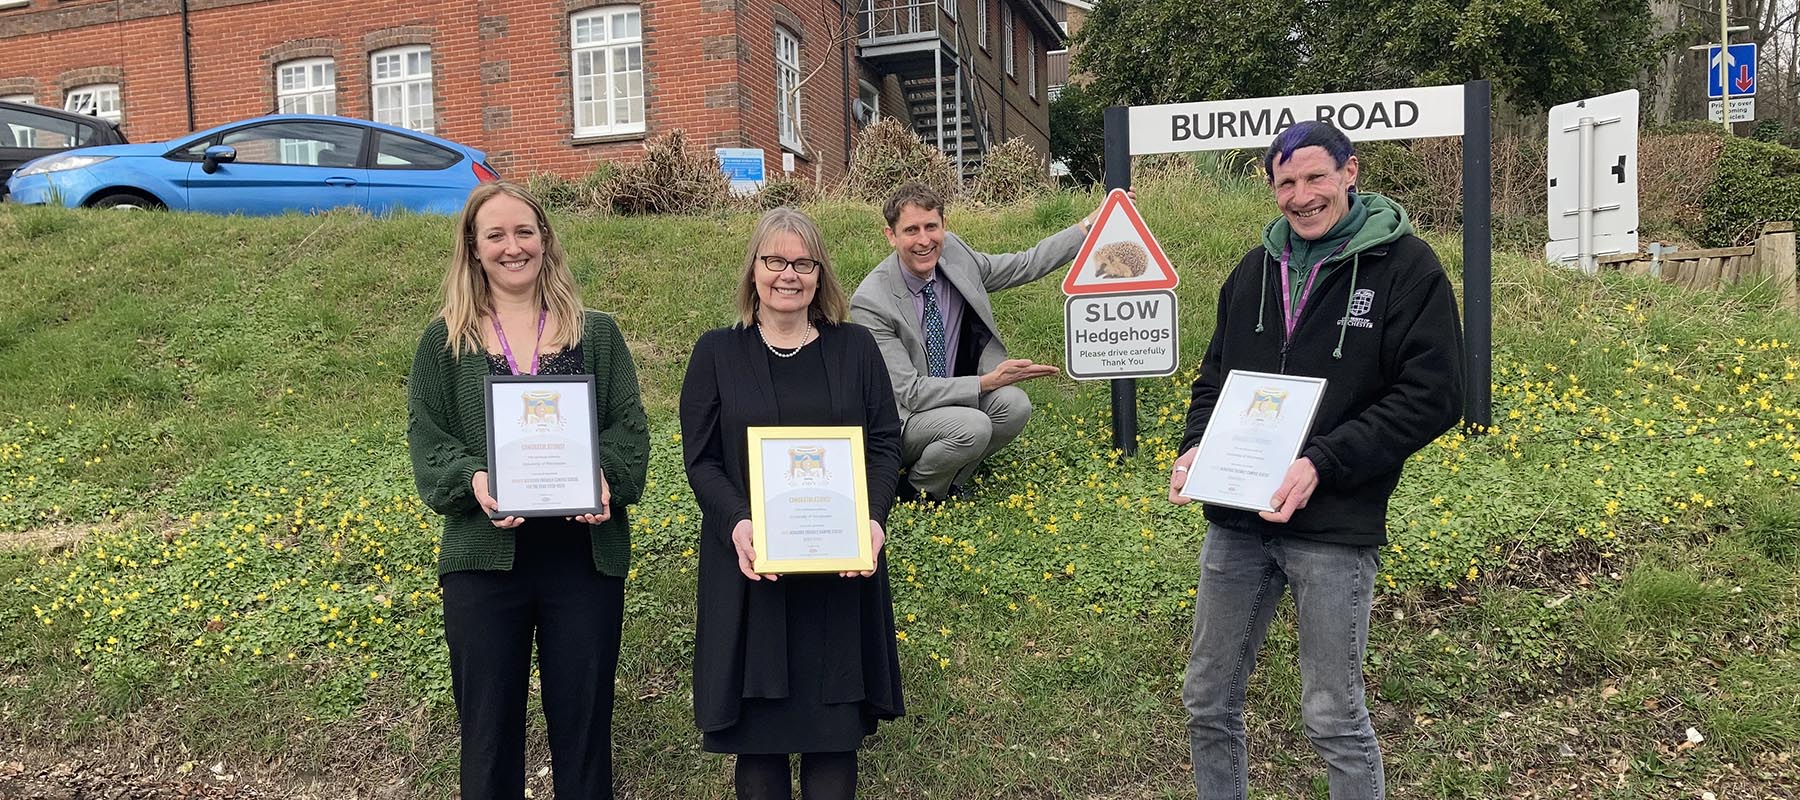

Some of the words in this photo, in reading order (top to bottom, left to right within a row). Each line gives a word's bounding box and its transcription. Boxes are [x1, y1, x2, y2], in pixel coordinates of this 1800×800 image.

[1171, 107, 1296, 142] BURMA
[1315, 100, 1419, 131] ROAD
[1085, 300, 1159, 323] SLOW
[1075, 326, 1170, 345] Hedgehogs
[1080, 350, 1106, 358] Please
[1108, 348, 1128, 357] drive
[1130, 346, 1166, 356] carefully
[1101, 358, 1126, 367] Thank
[1128, 357, 1144, 365] You
